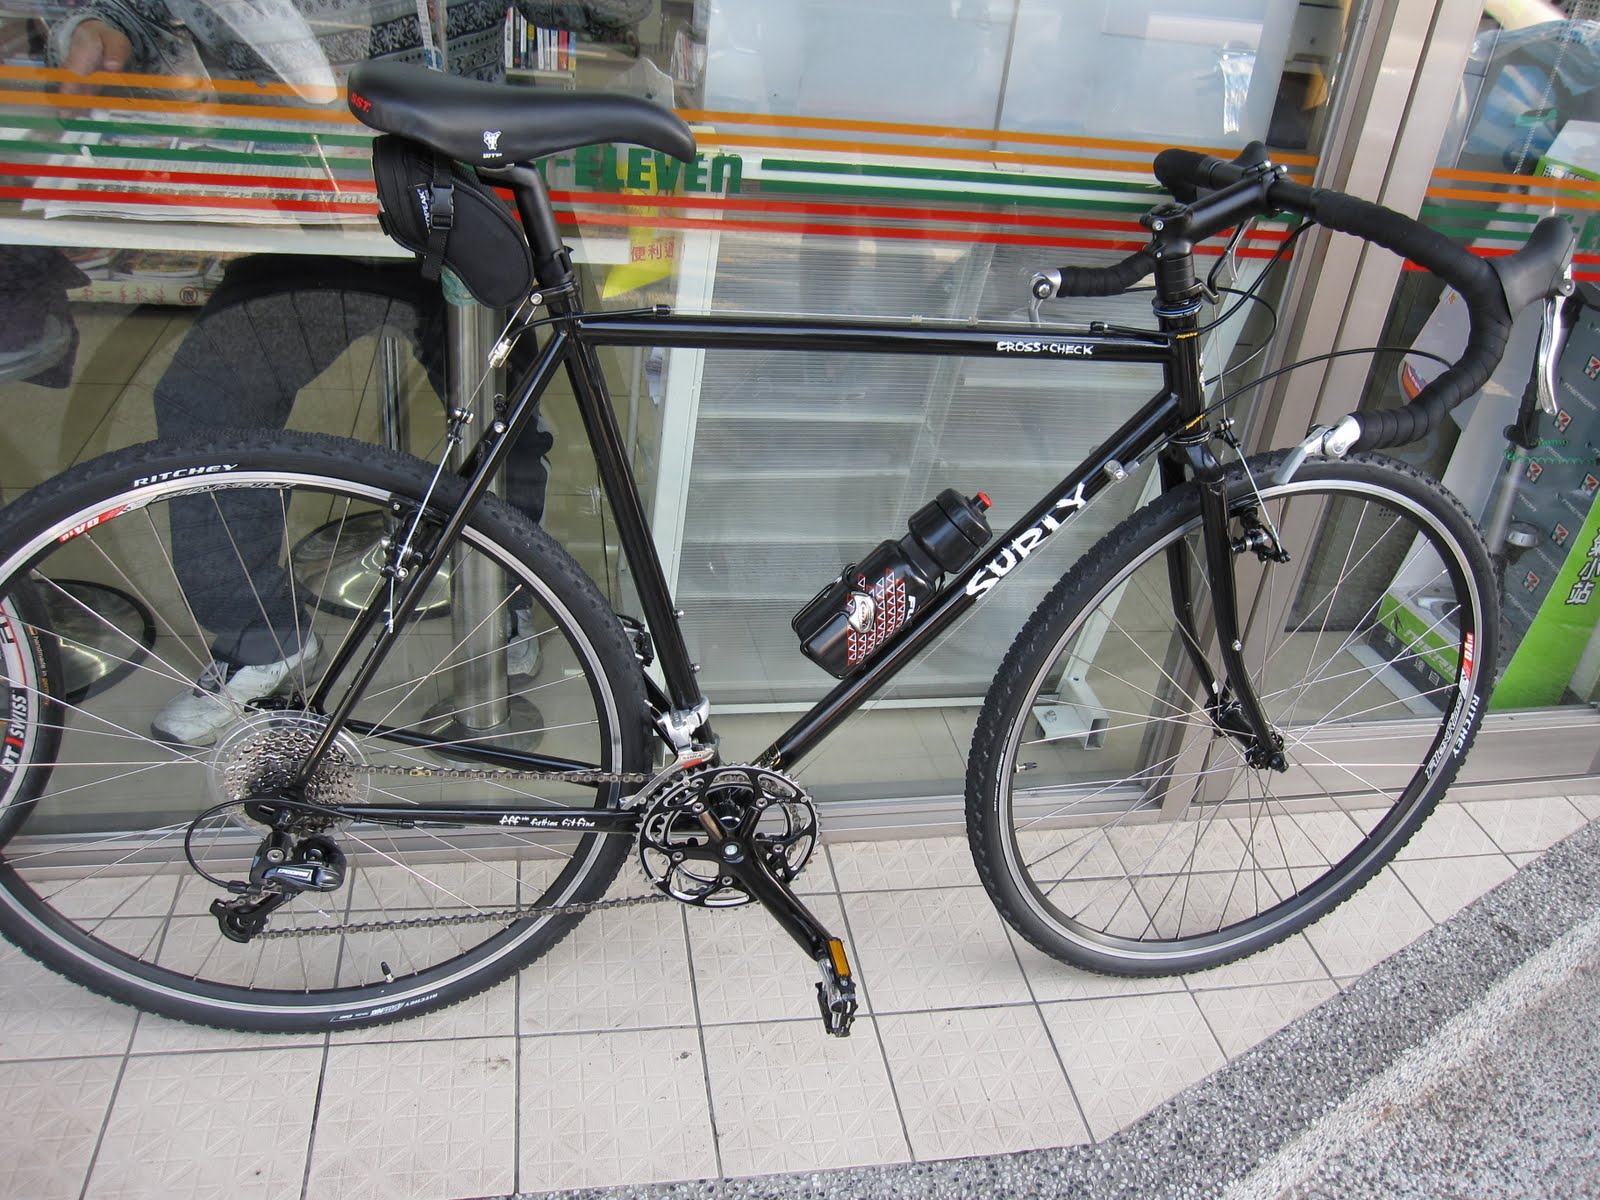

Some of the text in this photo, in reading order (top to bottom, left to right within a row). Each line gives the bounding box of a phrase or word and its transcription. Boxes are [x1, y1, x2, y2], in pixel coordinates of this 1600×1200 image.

[133, 463, 239, 488] RITCHEY
[965, 482, 1088, 601] SURLY
[2, 694, 28, 773] DT SWISS
[1451, 692, 1481, 759] RITCHEY
